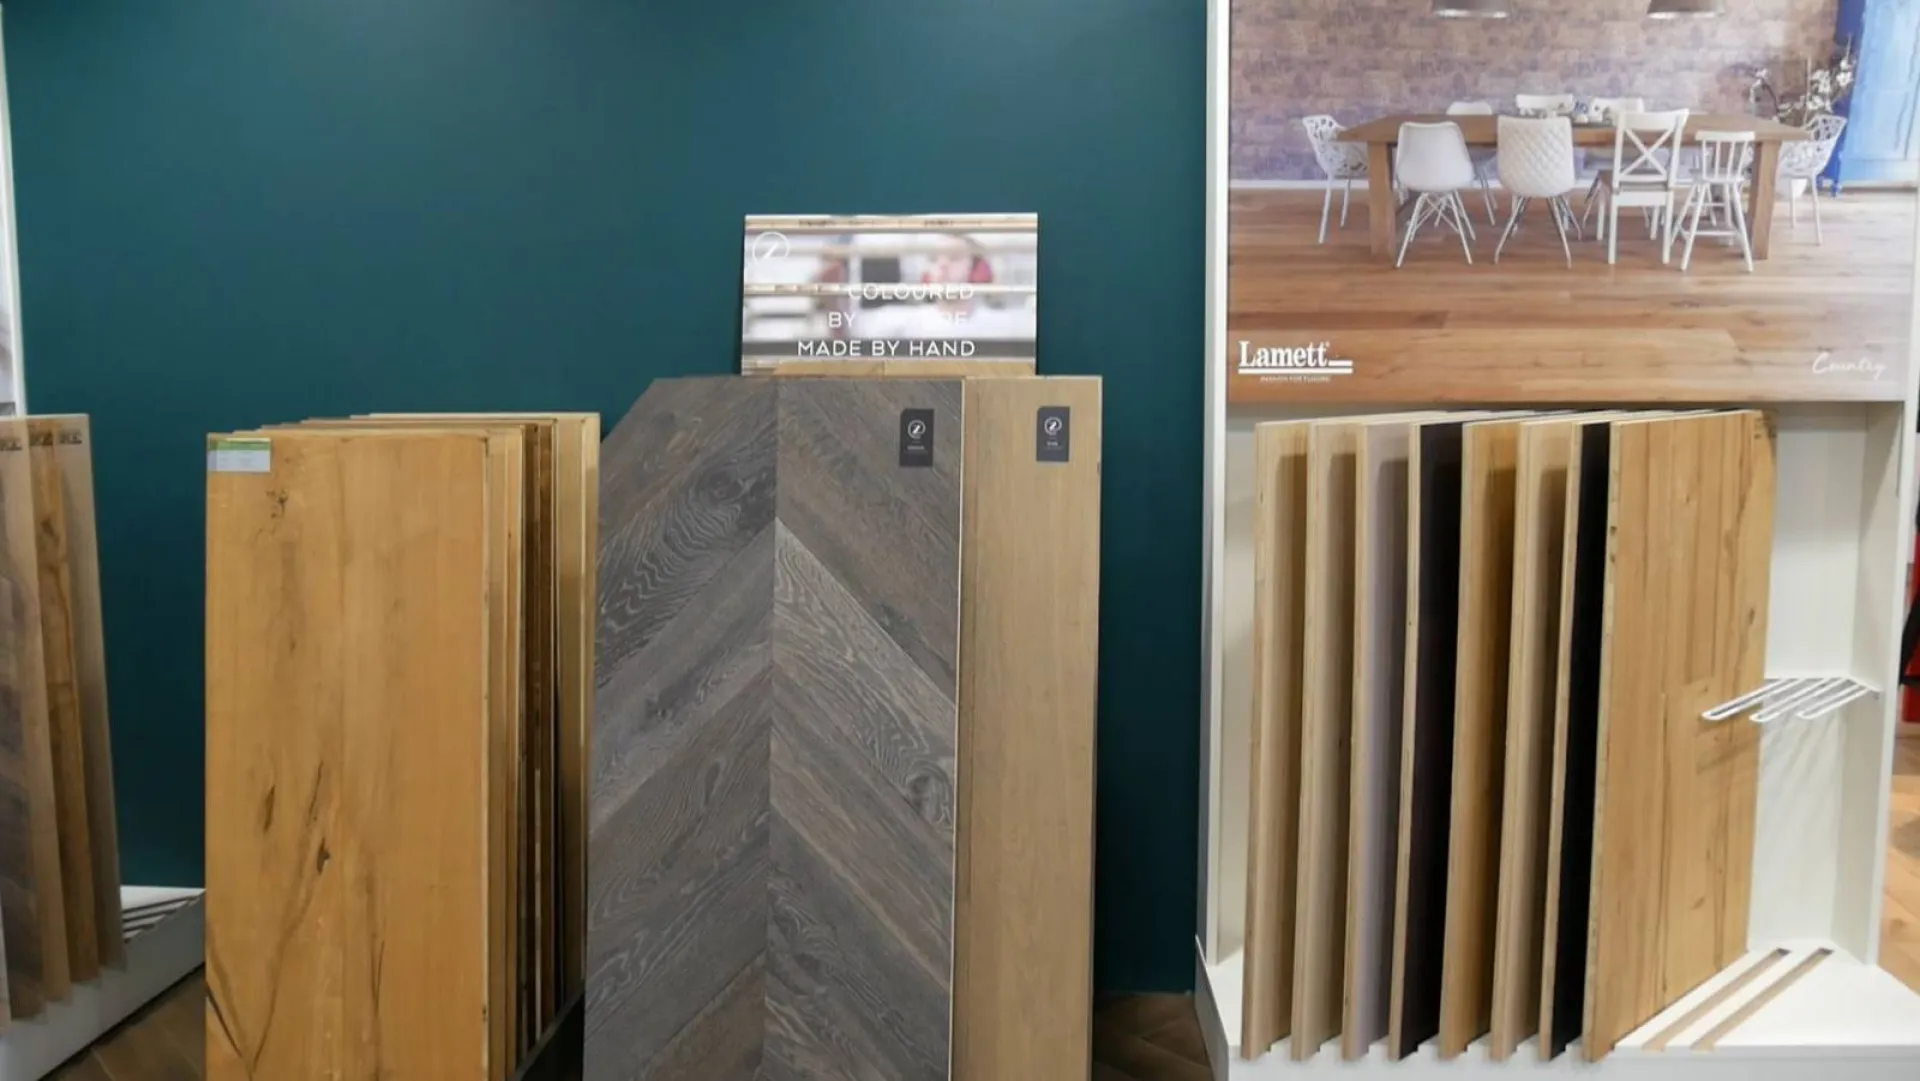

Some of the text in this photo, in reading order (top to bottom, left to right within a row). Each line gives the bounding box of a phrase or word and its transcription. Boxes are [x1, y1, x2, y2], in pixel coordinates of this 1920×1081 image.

[848, 283, 974, 300] COLOURED
[828, 311, 856, 328] BY
[797, 340, 976, 357] MADE BY HAND
[1238, 341, 1328, 368] Lamett
